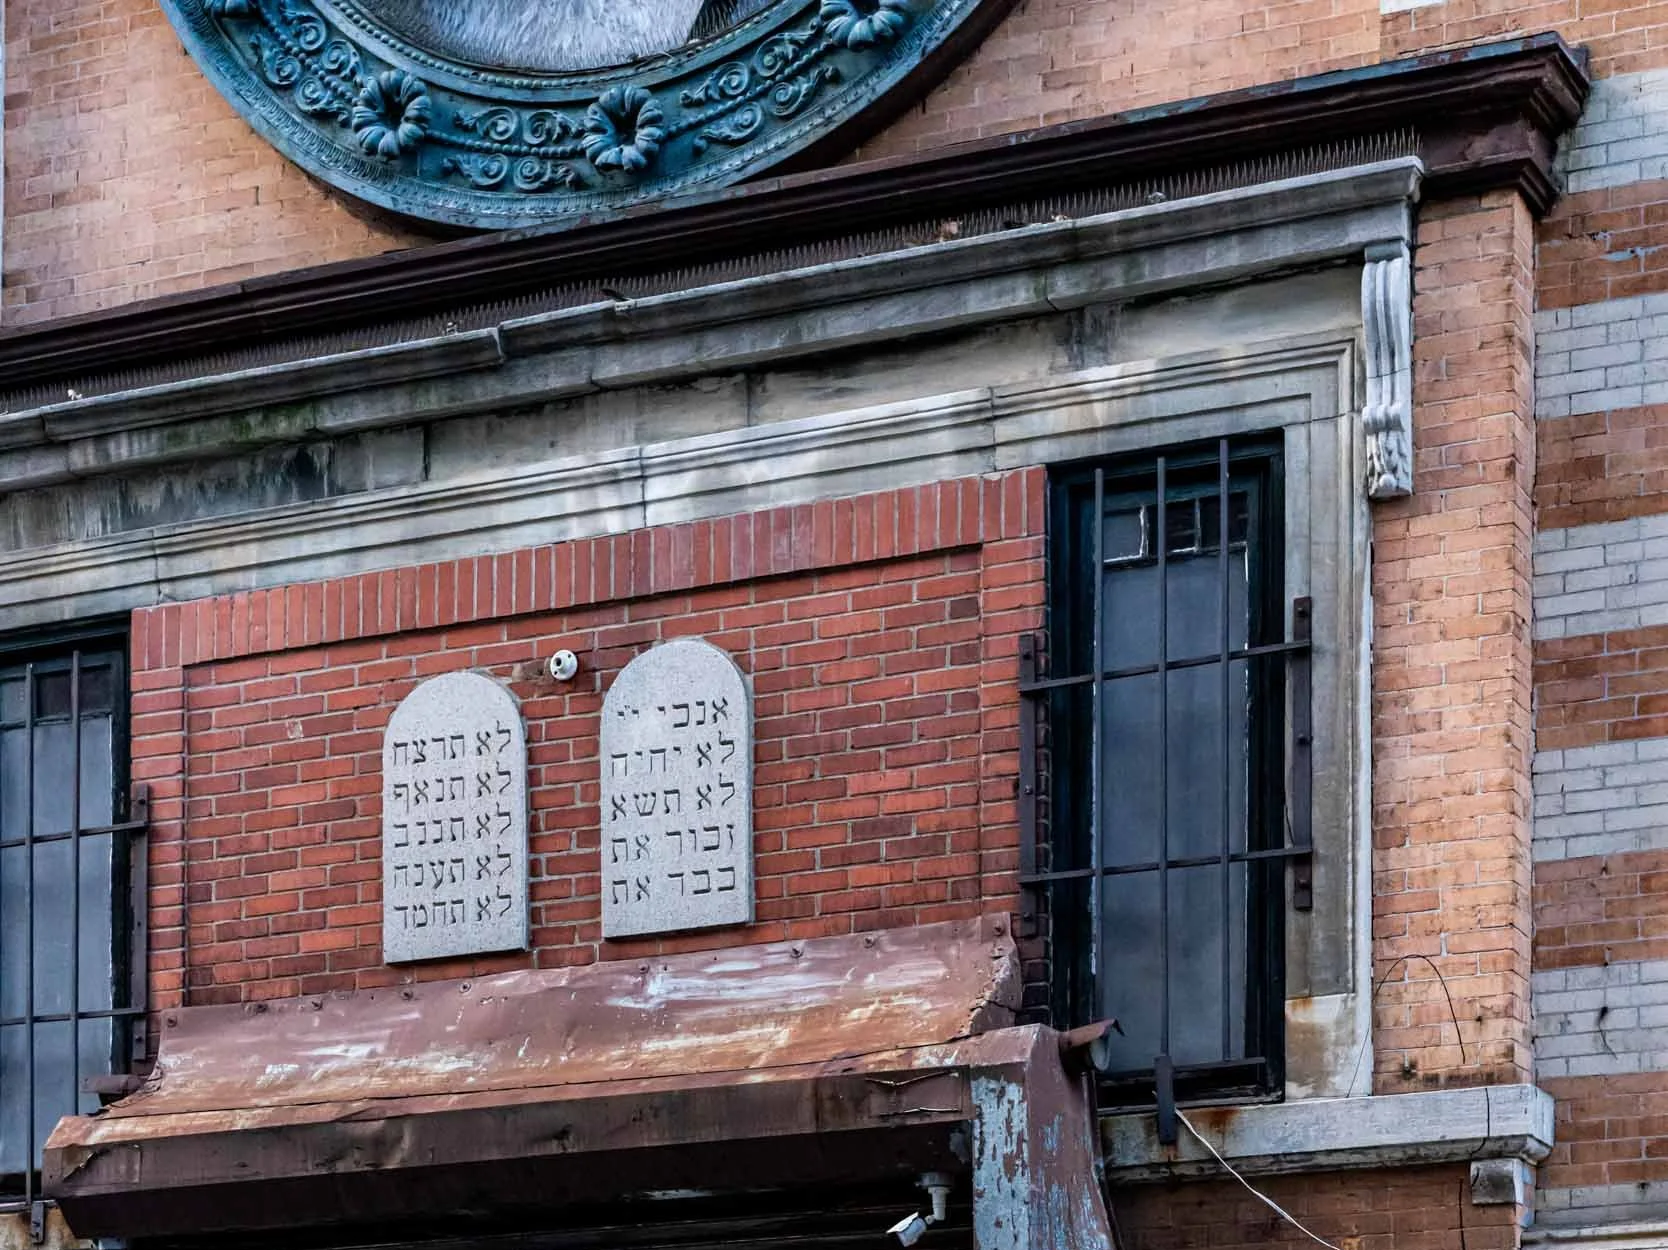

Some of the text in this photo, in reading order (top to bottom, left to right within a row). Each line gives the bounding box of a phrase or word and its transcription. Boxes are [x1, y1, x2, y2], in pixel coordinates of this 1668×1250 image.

[392, 719, 511, 766] לא תרצח
[610, 729, 735, 777] לא יהיה
[393, 760, 512, 815] לא תנאף
[611, 772, 736, 821] לא תשא
[476, 801, 512, 839] לא
[393, 843, 512, 889] לא תענה
[611, 824, 735, 864] זכור את
[393, 884, 512, 929] לא תחמד
[611, 866, 736, 904] כבד את
